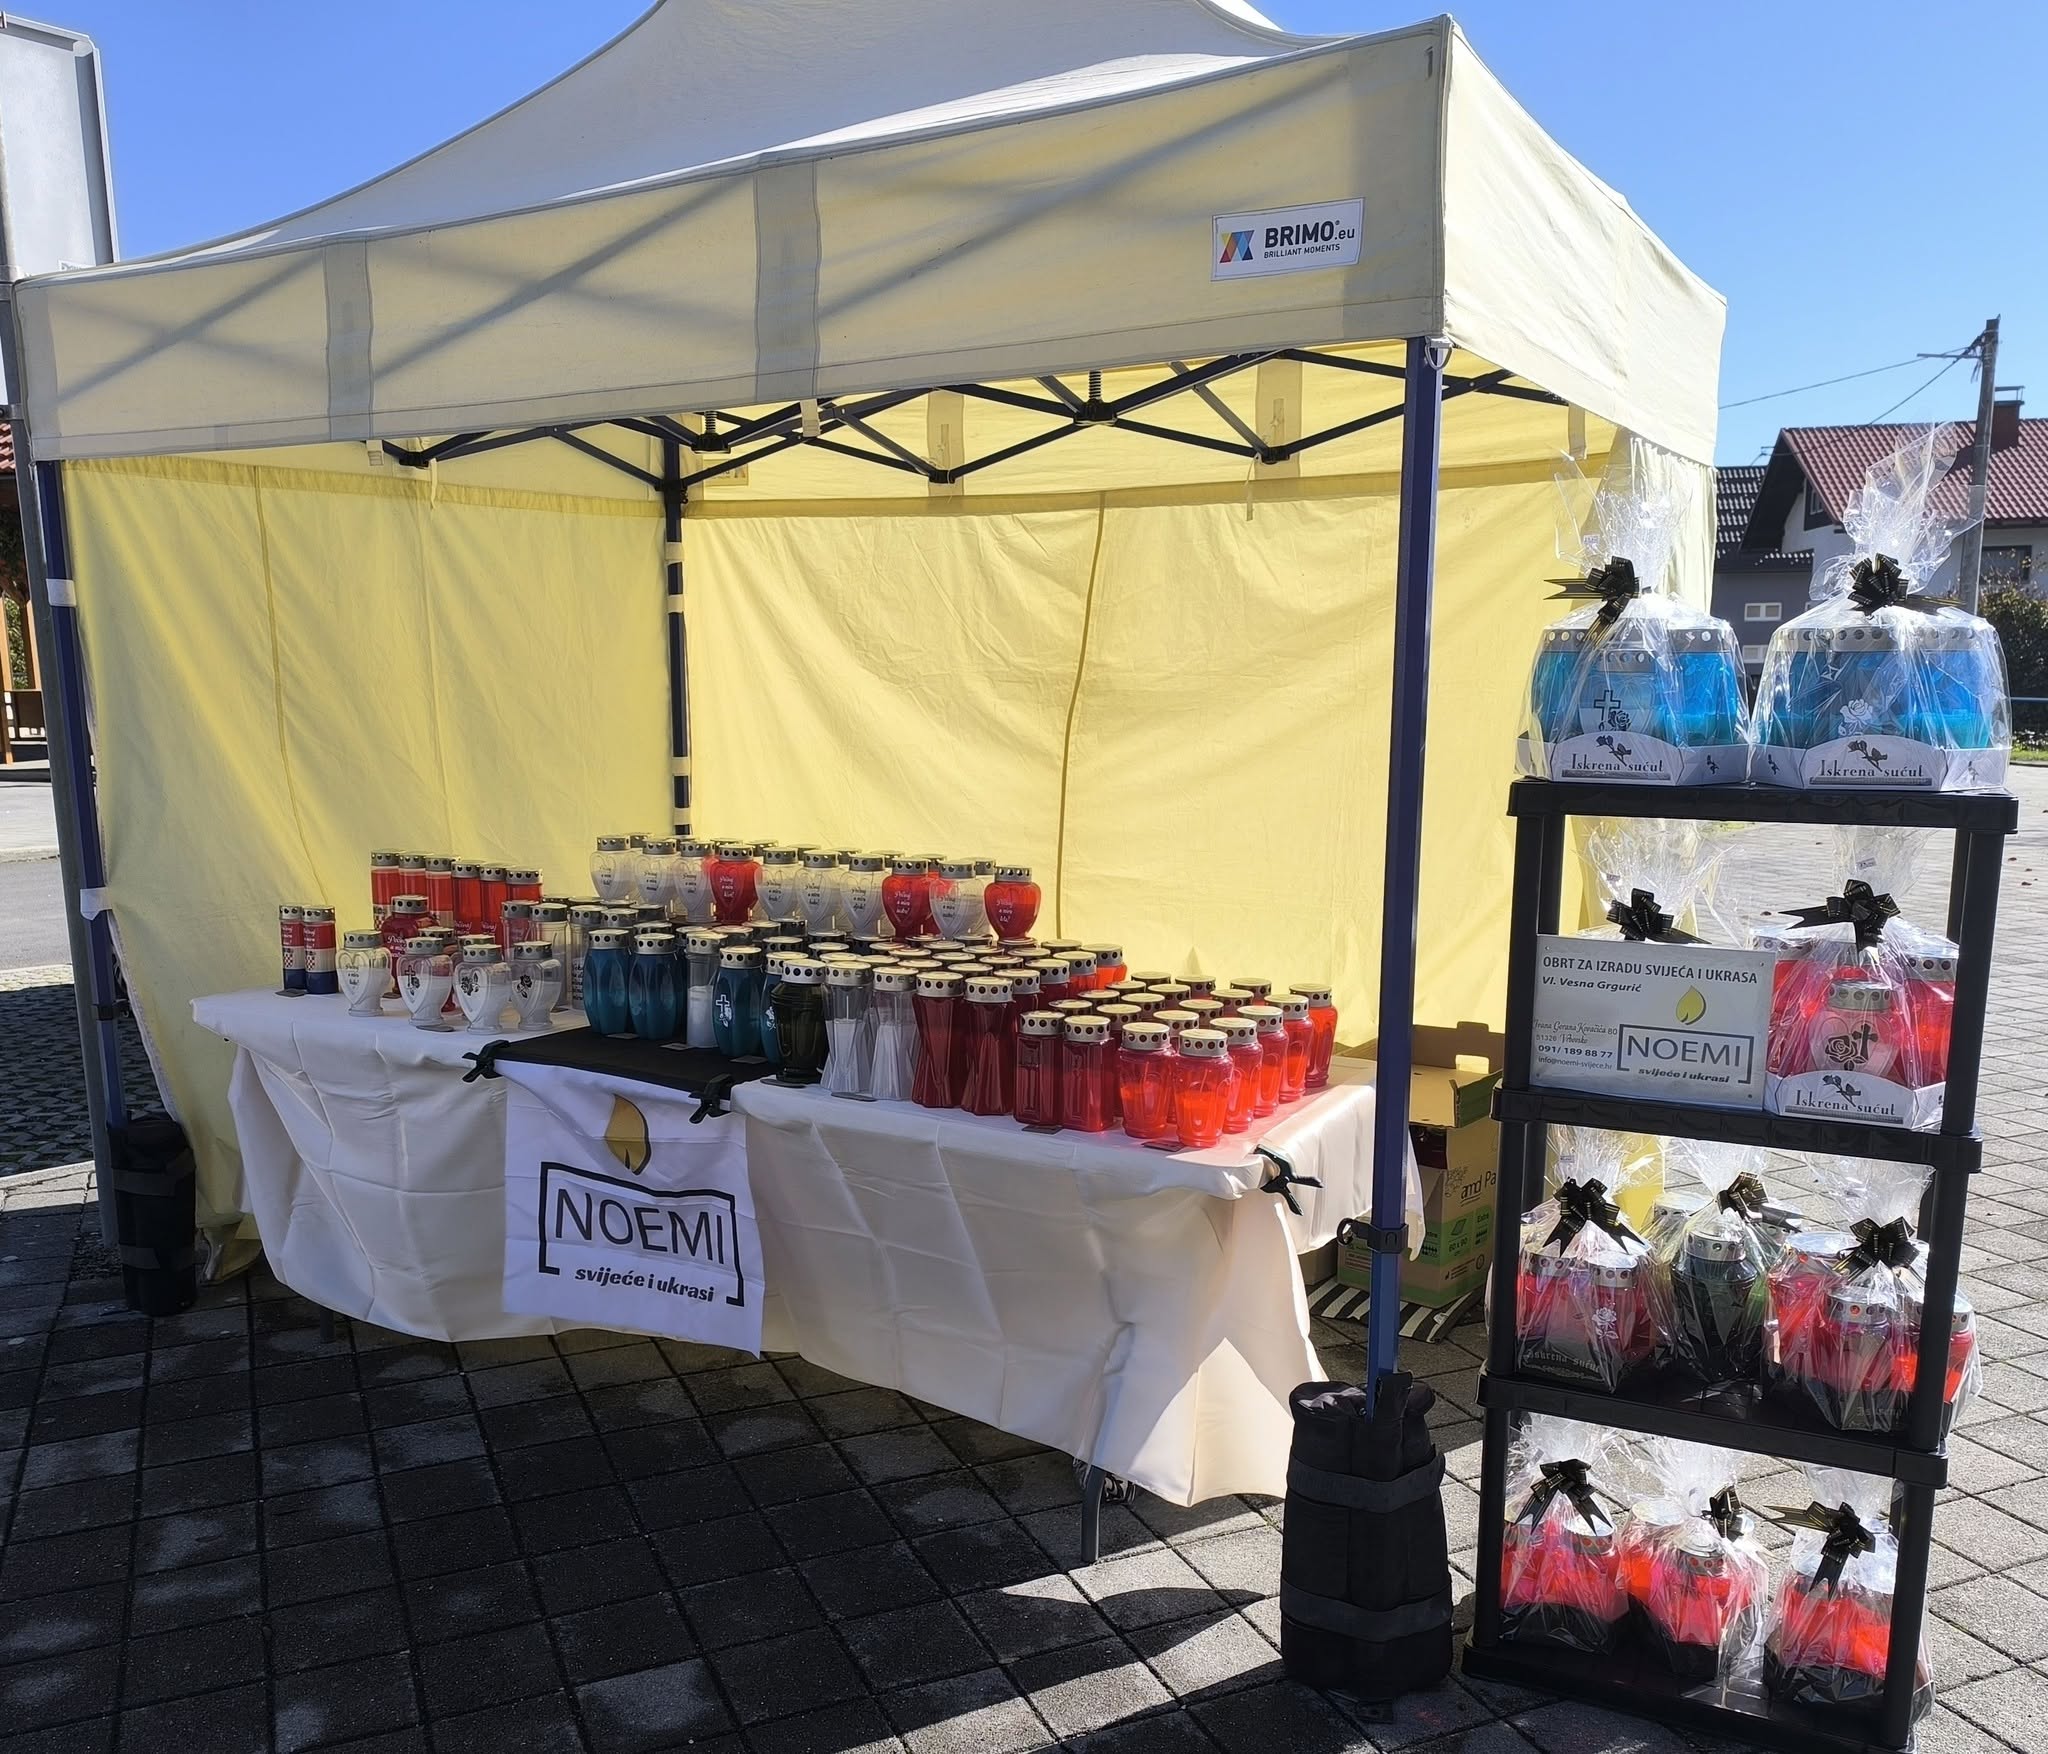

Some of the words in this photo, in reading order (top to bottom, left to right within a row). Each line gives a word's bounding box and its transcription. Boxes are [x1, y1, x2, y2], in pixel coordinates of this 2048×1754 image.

[1264, 248, 1302, 258] BRILLIANT
[1303, 243, 1341, 254] MOMENTS
[1571, 753, 1620, 770] Iskrena
[1628, 759, 1663, 772] sućut
[1820, 759, 1875, 777] Iskrena
[1884, 765, 1923, 777] sućut
[1543, 956, 1575, 969] OBRT
[1577, 959, 1593, 970] ZA
[1596, 960, 1642, 974] IZRADU
[1645, 963, 1694, 979] SVIJEĆA
[1698, 968, 1702, 979] I
[1705, 971, 1757, 984] UKRASA
[1560, 978, 1594, 988] Vesna
[1596, 981, 1642, 993] Grgurić
[1538, 1045, 1561, 1054] 091/
[1564, 1047, 1582, 1055] 189
[1585, 1049, 1598, 1058] 88
[1600, 1051, 1613, 1059] 77
[1627, 1035, 1741, 1067] NOEMI
[1689, 1073, 1730, 1083] ukrasi
[1794, 1090, 1849, 1111] Iskrena
[1857, 1102, 1896, 1116] sućut
[555, 1188, 725, 1265] NOEMI
[574, 1267, 645, 1288] svijeće
[647, 1273, 655, 1289] i
[656, 1276, 715, 1302] ukrasi
